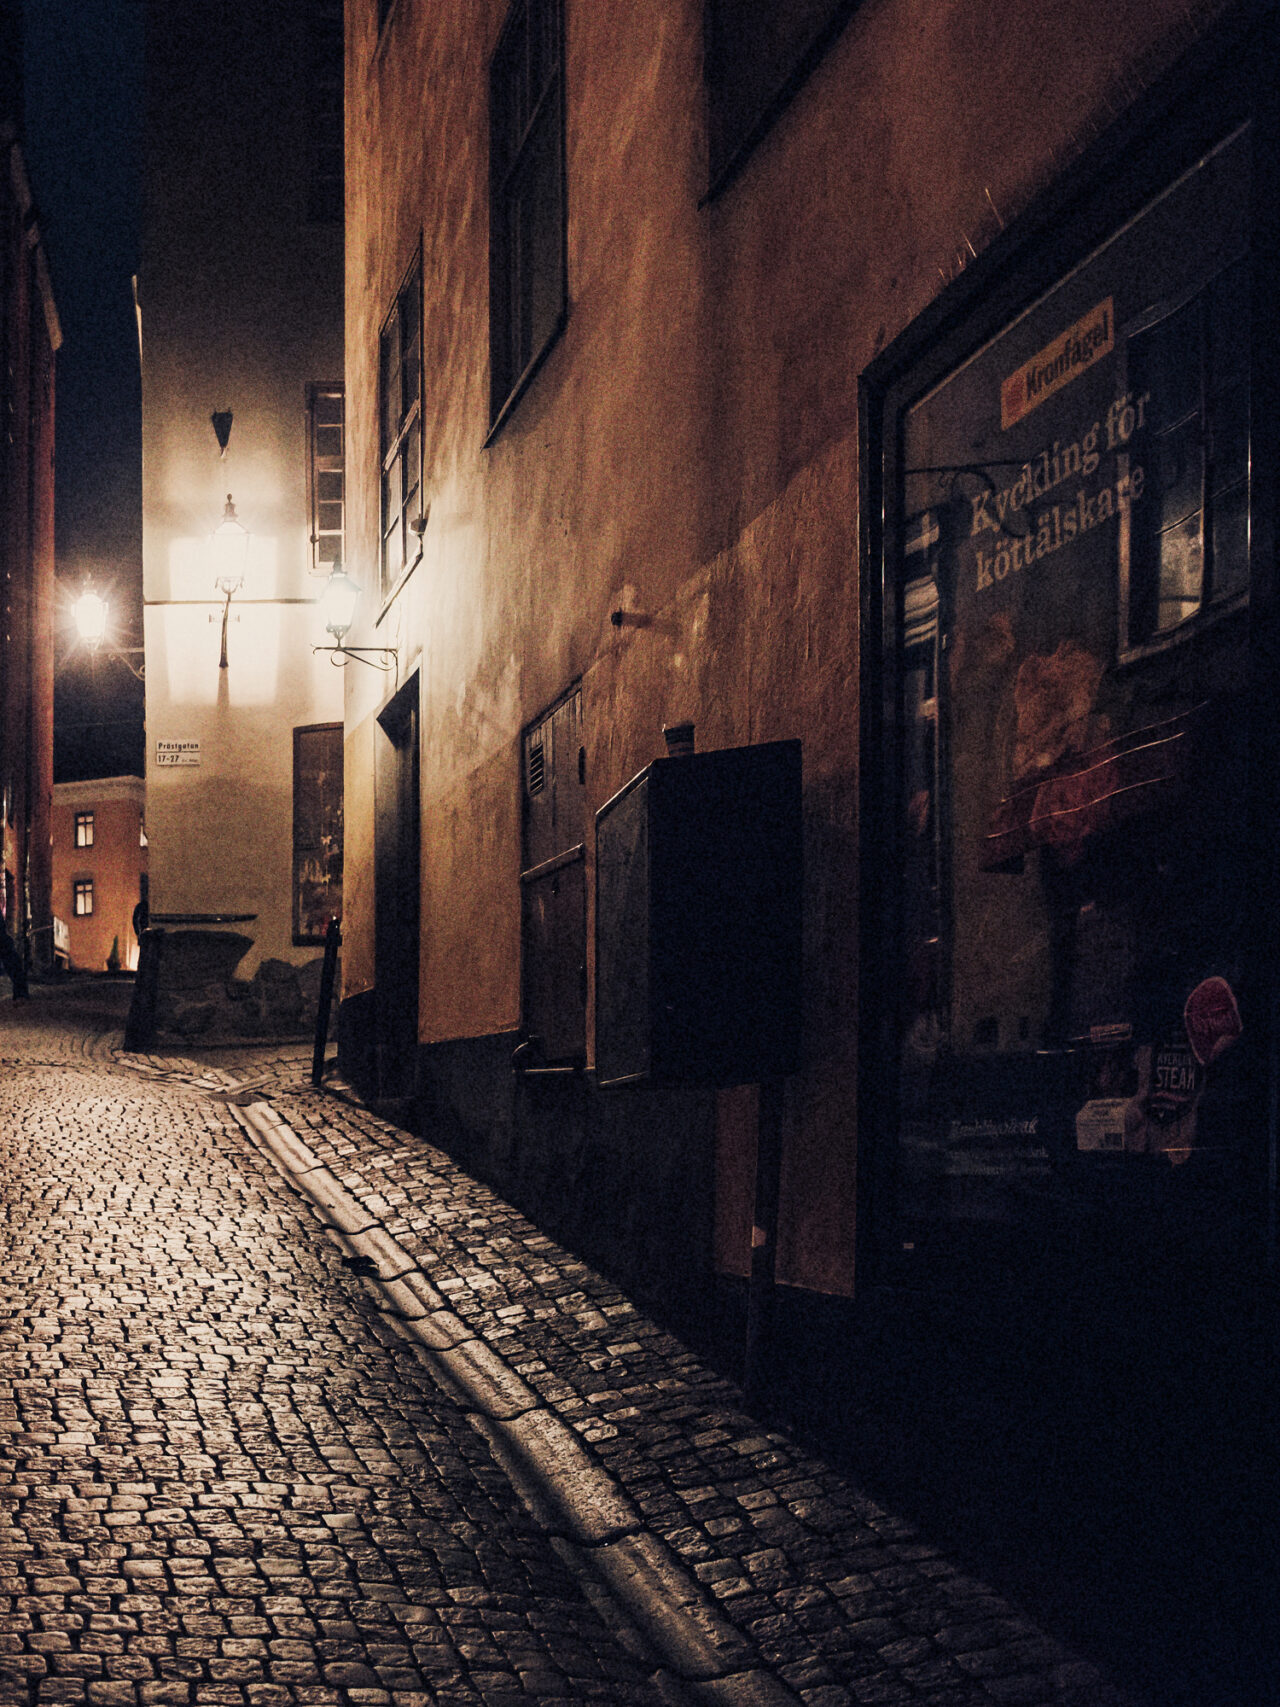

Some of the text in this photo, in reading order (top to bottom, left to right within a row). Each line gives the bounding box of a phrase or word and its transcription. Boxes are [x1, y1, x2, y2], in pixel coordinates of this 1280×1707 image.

[1026, 311, 1109, 401] Kronfågel
[970, 391, 1151, 537] Kyckling för
[975, 464, 1146, 593] köttälskare
[158, 742, 199, 752] Prästgatan
[1155, 1066, 1195, 1090] STEAK
